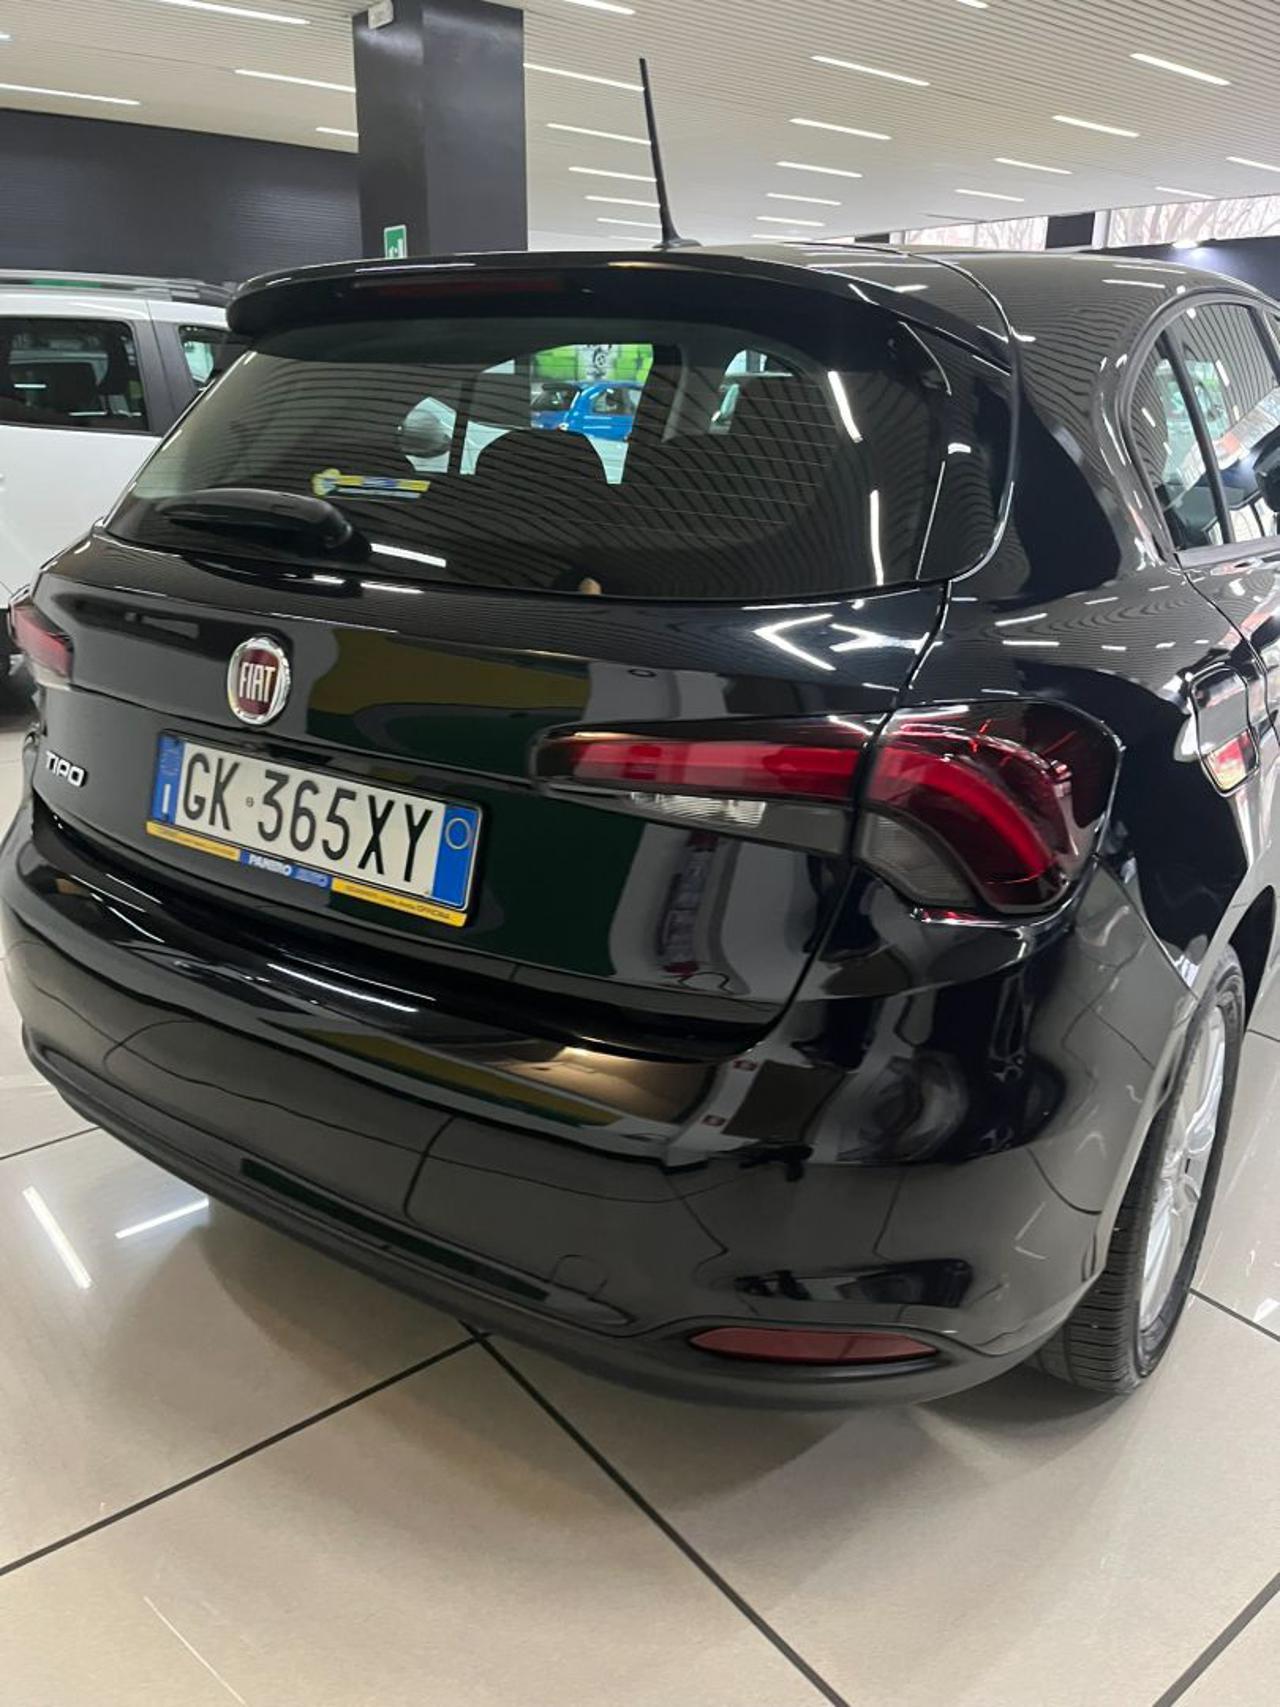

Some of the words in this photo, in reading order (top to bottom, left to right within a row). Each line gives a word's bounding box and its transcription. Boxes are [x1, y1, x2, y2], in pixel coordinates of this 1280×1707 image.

[239, 661, 276, 703] FIAT
[46, 750, 85, 787] TIPO
[182, 753, 240, 832] GK
[257, 769, 434, 883] 365XY
